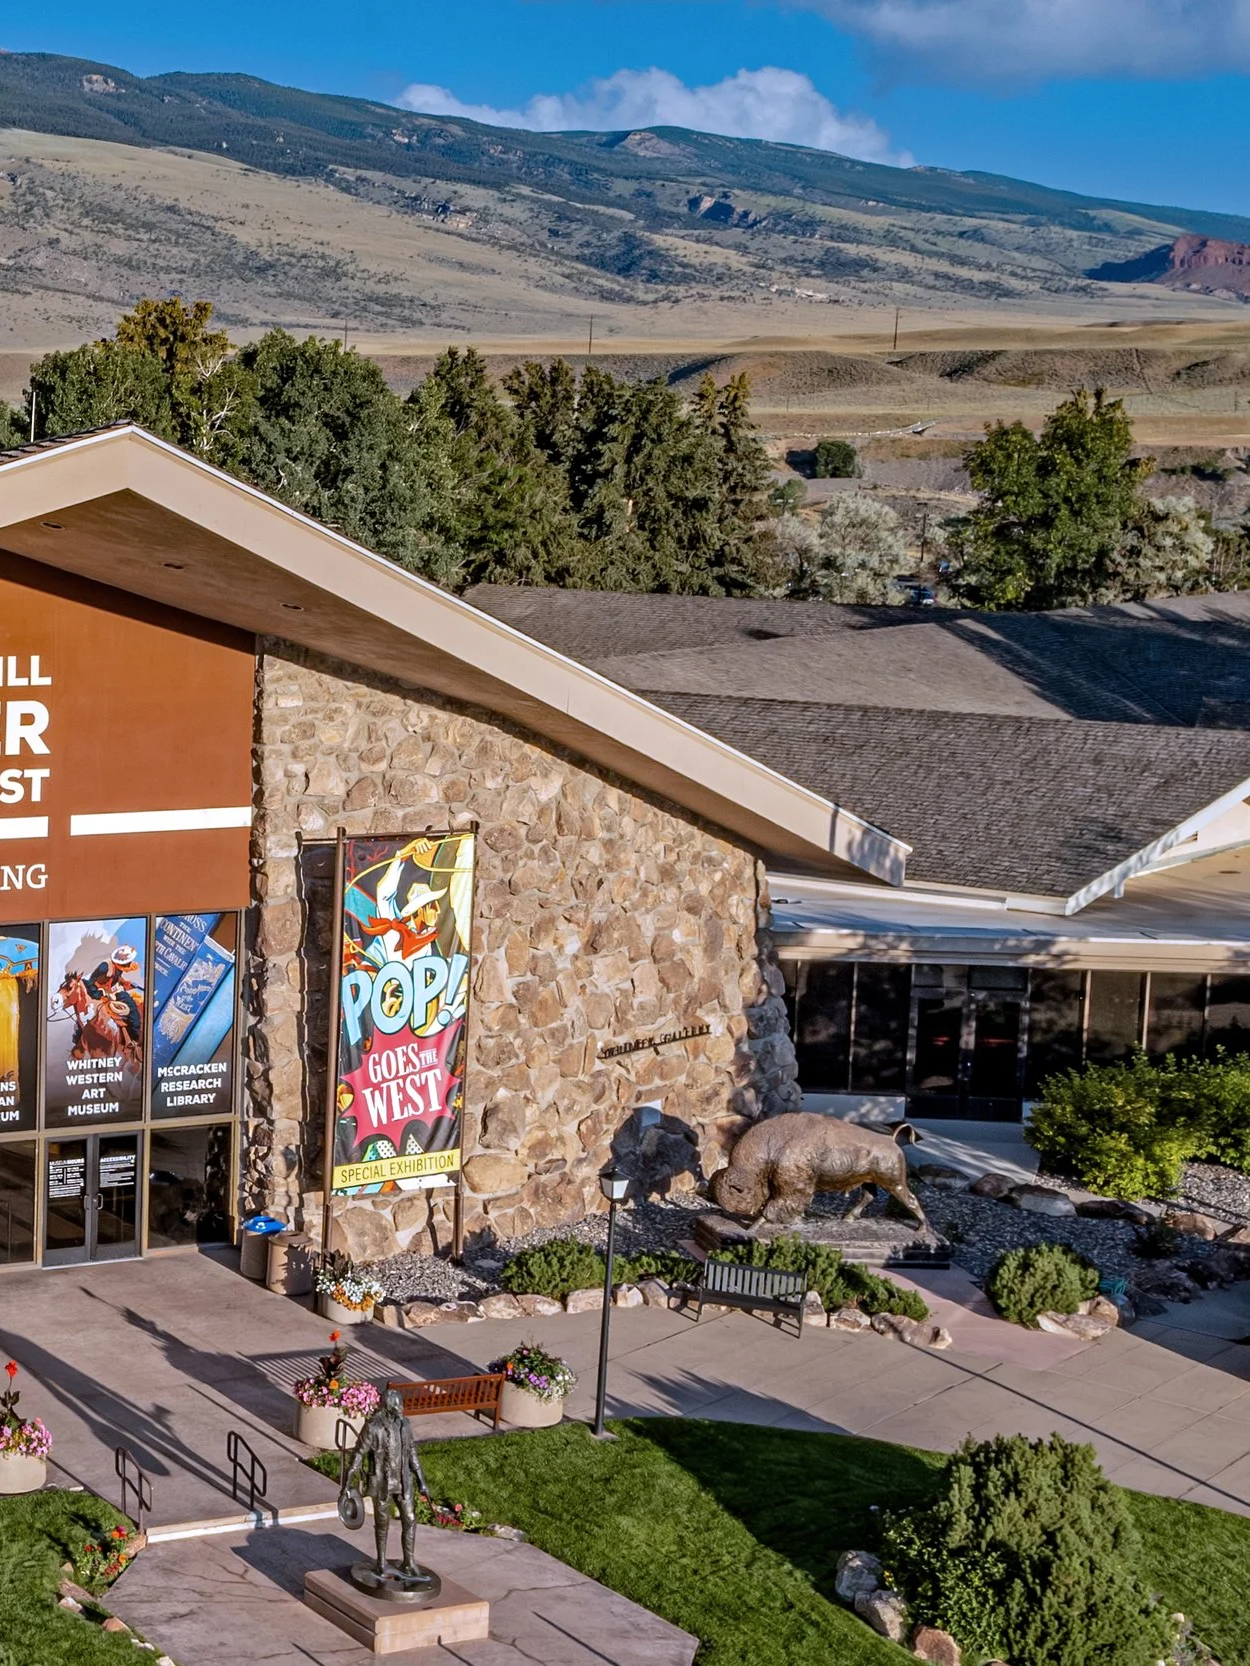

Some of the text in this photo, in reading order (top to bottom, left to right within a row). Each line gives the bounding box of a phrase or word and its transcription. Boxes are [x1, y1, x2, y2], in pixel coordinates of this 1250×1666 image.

[341, 953, 469, 1047] POP!
[66, 1056, 122, 1071] WHITNEY
[368, 1043, 438, 1085] GOES THE
[66, 1071, 123, 1086] WESTERN
[160, 1078, 222, 1093] RESEARCH
[82, 1086, 106, 1100] ART
[166, 1093, 216, 1107] LIBRARY
[362, 1068, 443, 1129] WEST
[67, 1101, 120, 1116] MUSEUM
[341, 1154, 454, 1184] SPECIAL EXHIBITION
